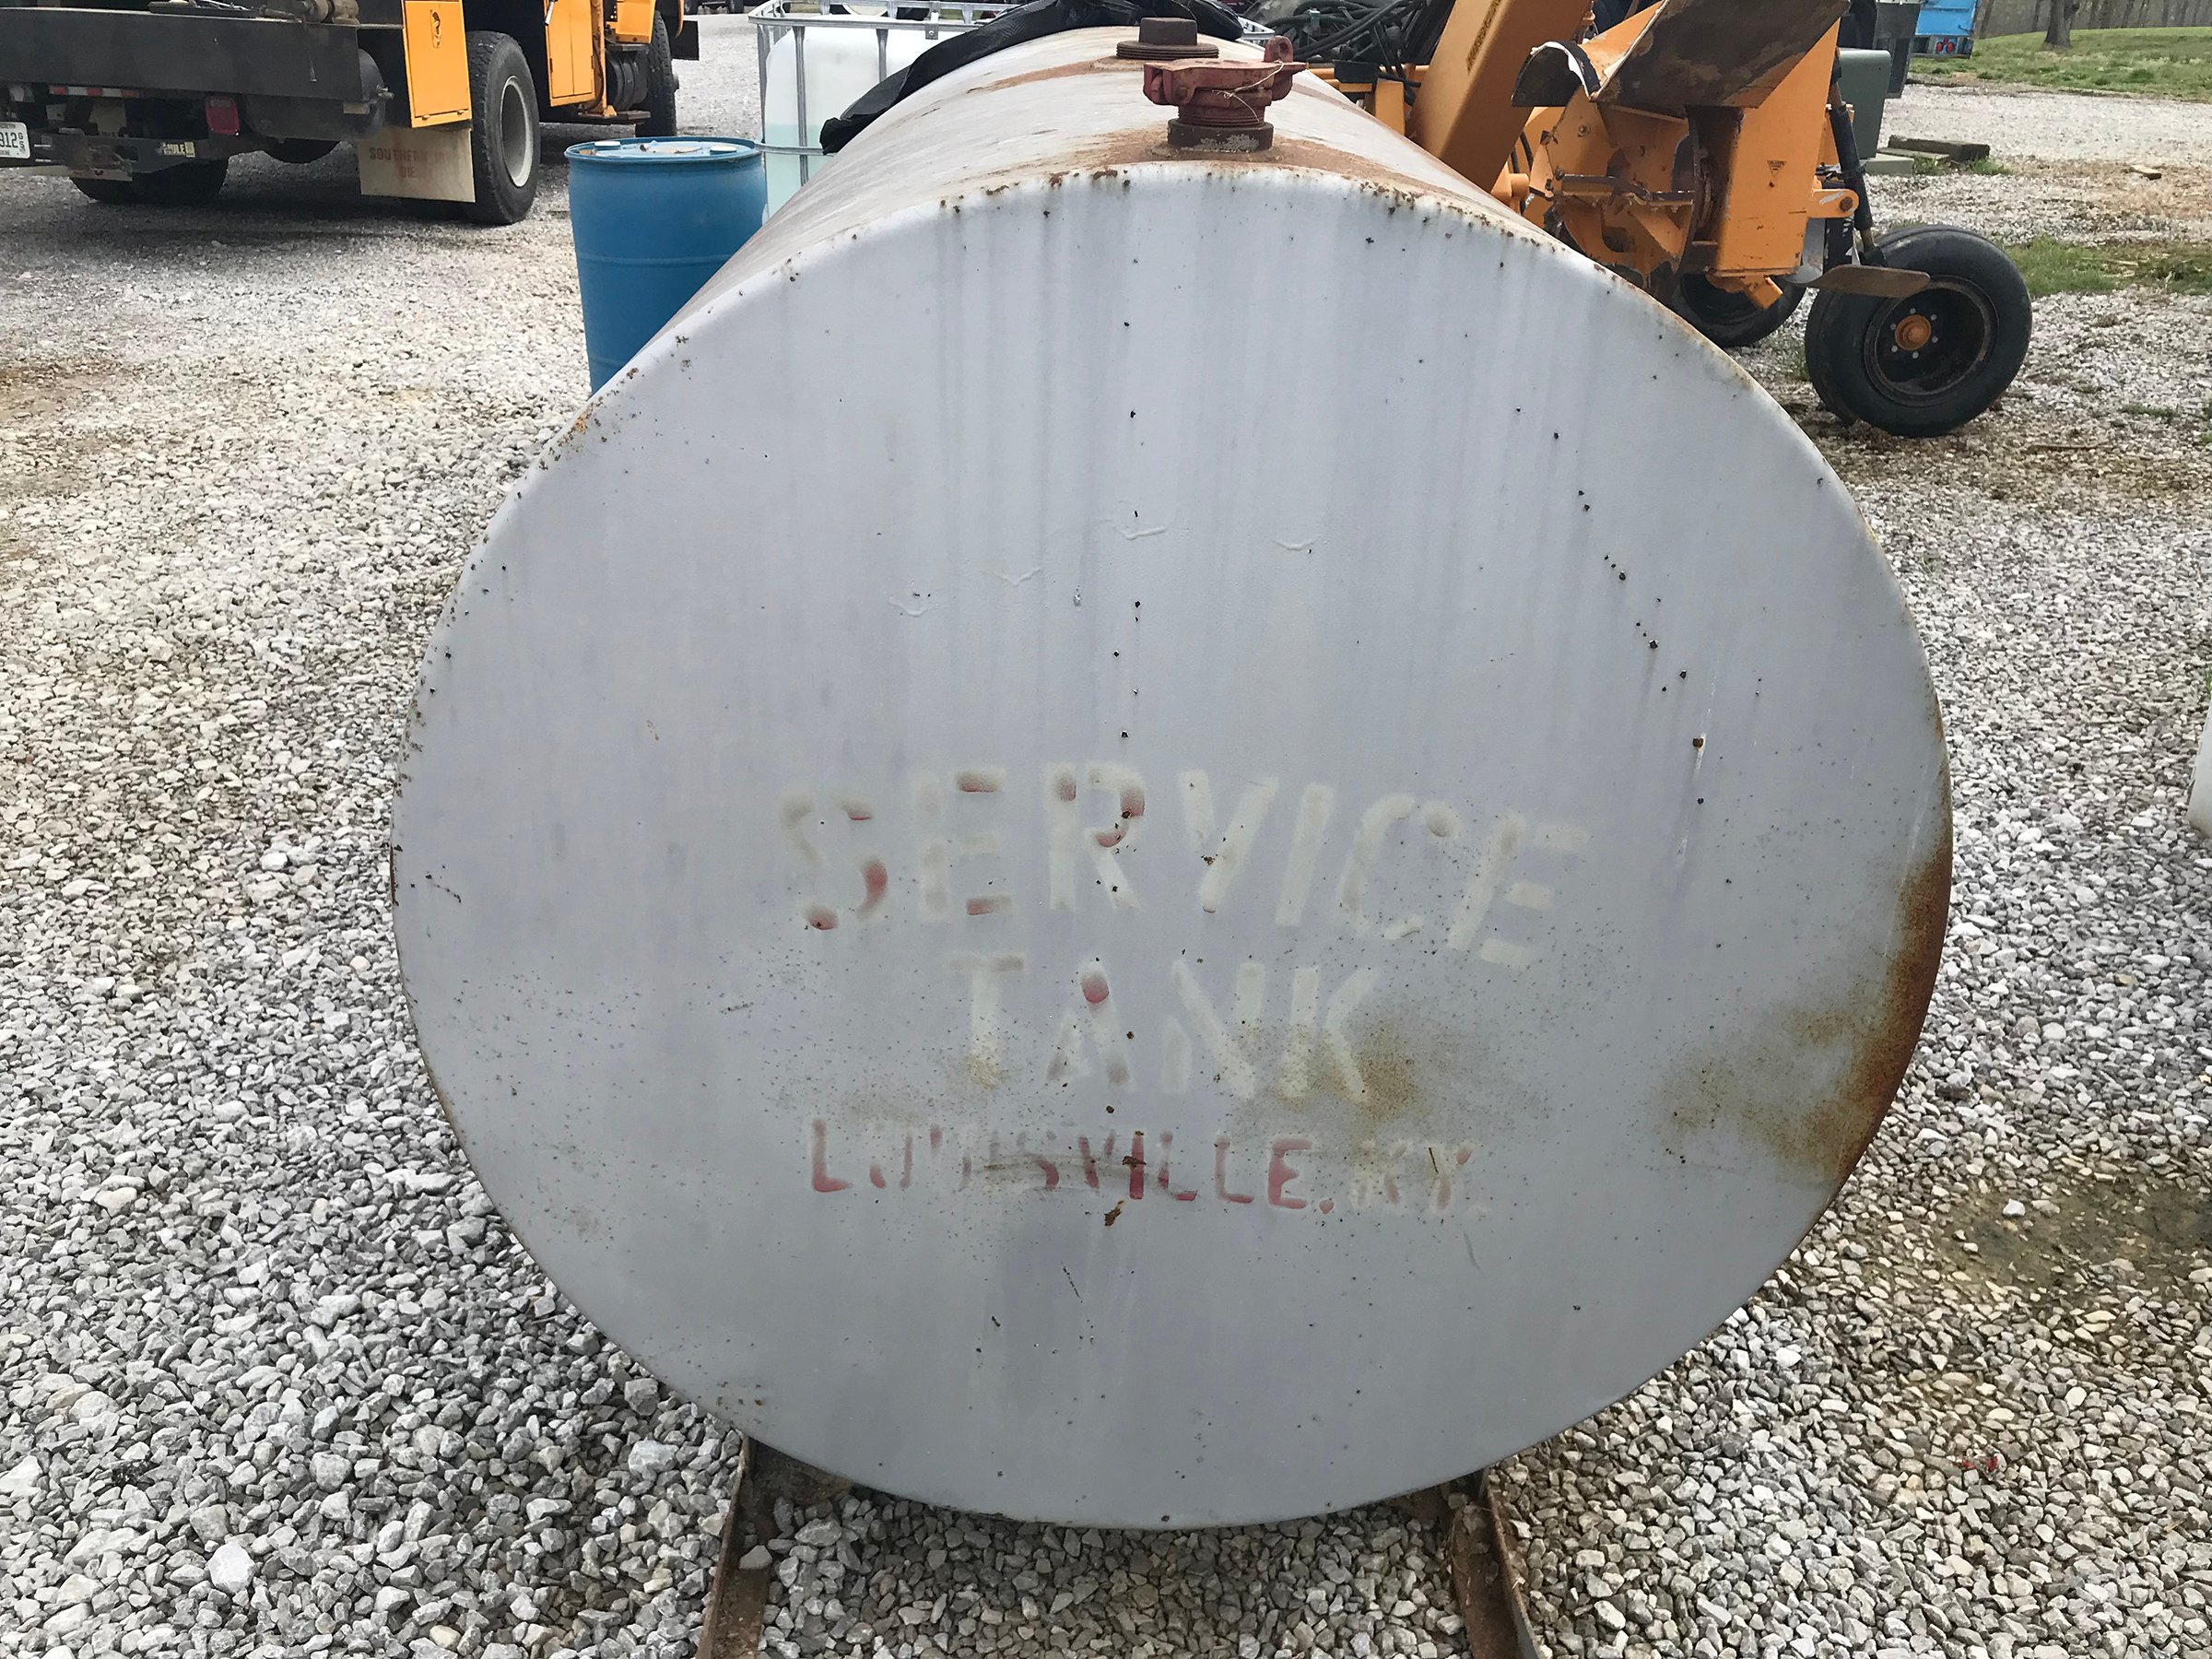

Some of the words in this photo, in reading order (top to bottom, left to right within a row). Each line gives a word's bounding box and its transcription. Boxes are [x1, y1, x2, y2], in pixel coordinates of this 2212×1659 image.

[369, 147, 429, 162] SOUTHERN
[780, 762, 1594, 966] SERVICE
[941, 947, 1377, 1107] TANK
